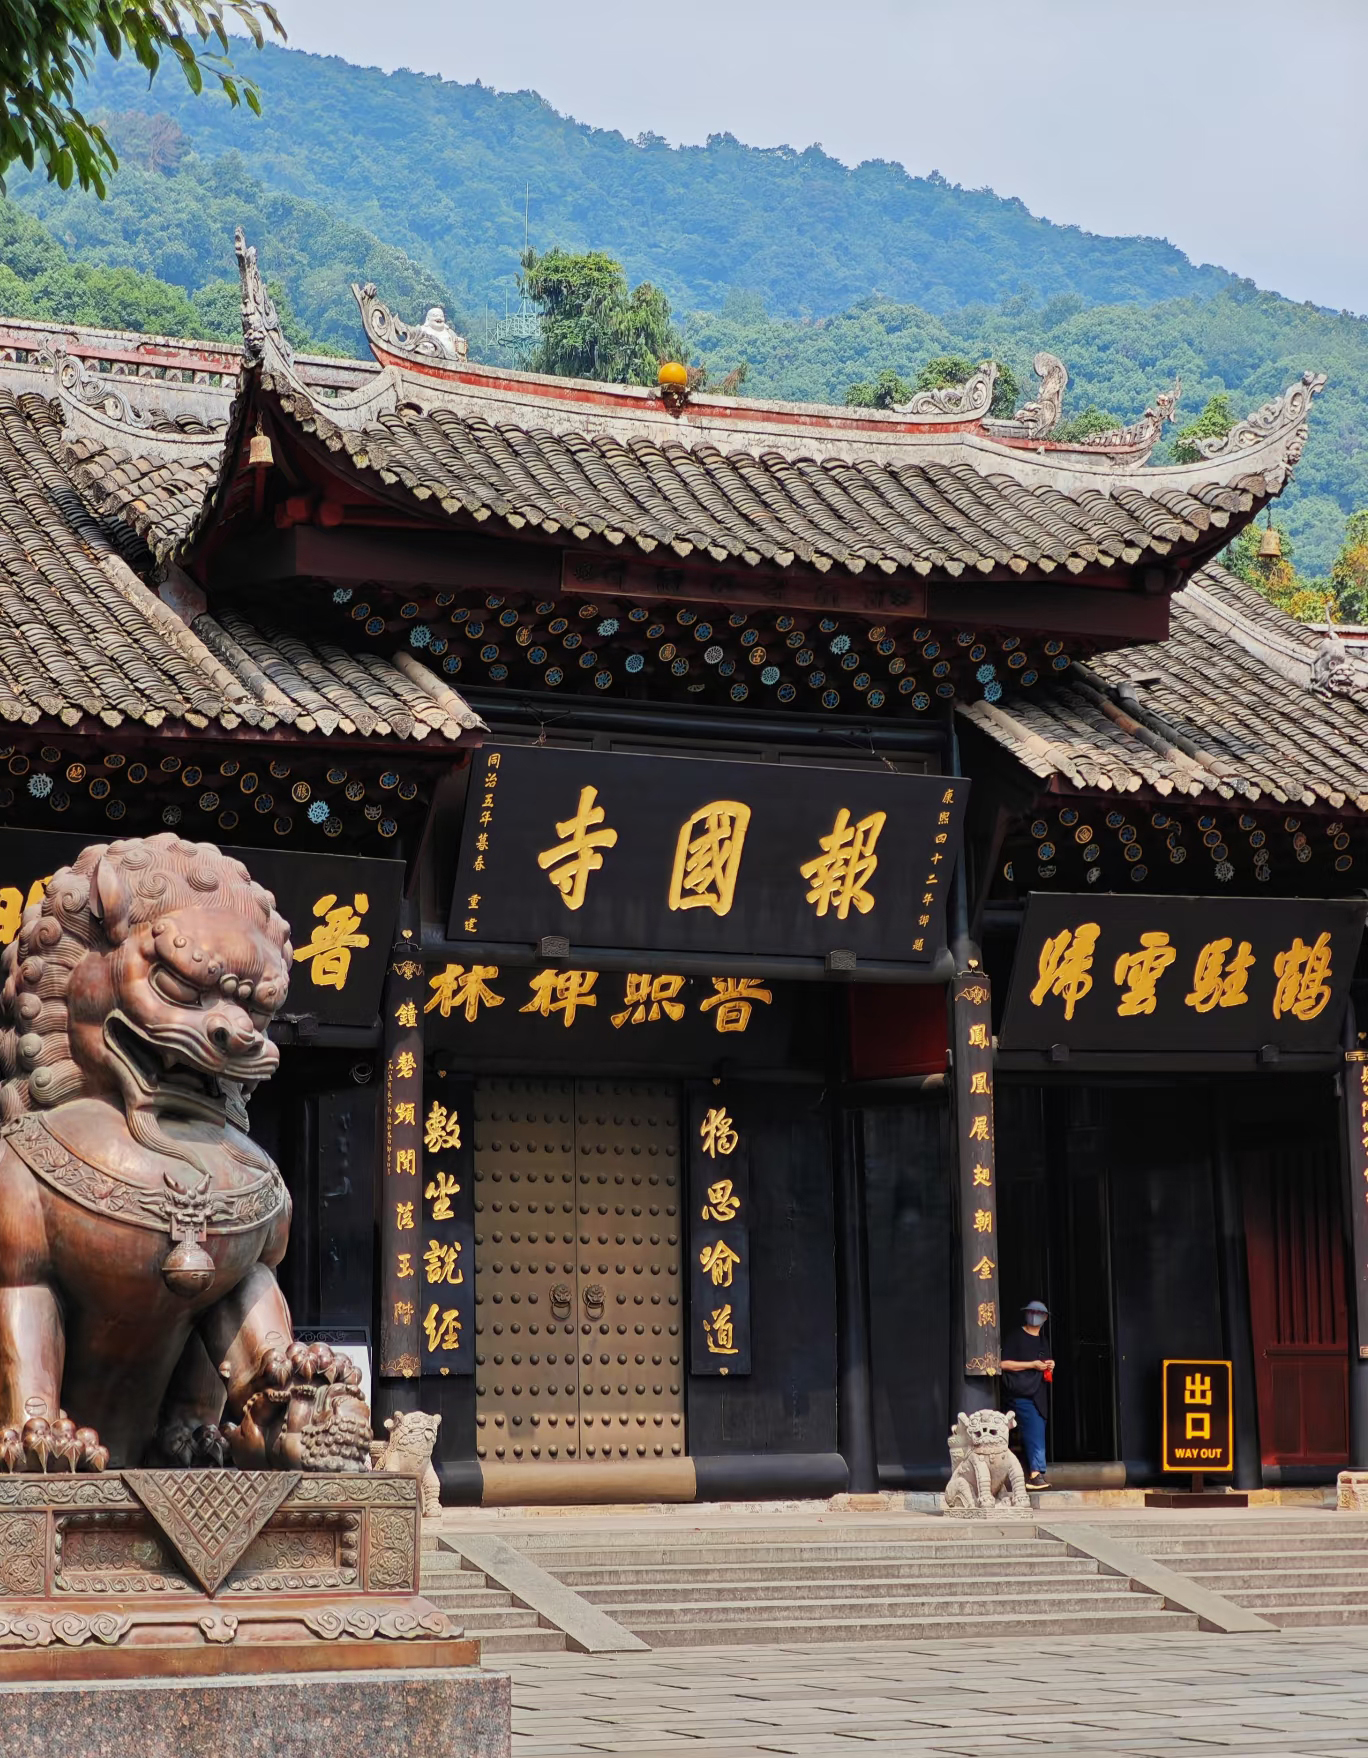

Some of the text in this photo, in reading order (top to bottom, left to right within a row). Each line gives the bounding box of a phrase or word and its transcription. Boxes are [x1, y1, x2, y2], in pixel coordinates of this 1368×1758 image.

[1184, 1373, 1212, 1440] 出口
[1175, 1448, 1222, 1458] WAY OUT
